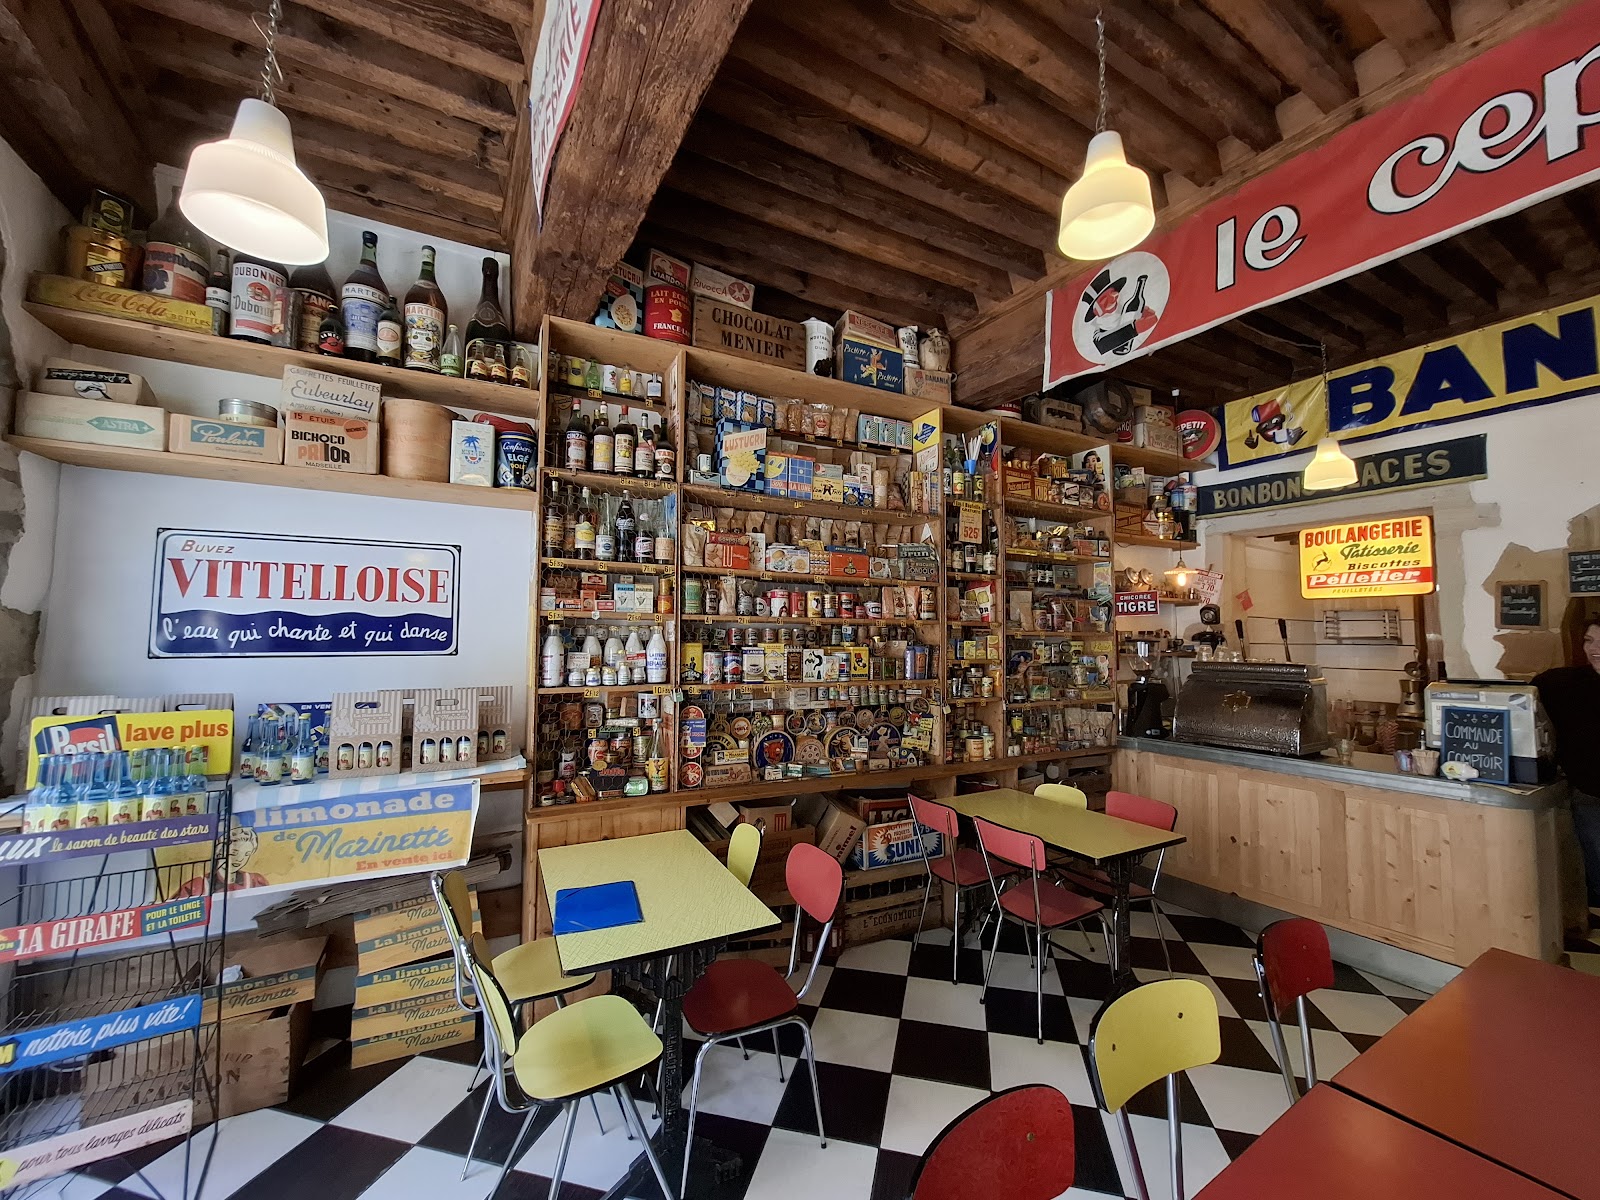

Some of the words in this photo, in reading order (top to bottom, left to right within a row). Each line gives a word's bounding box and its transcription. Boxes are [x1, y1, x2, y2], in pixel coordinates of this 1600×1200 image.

[1215, 204, 1308, 292] le
[73, 284, 168, 318] Coca-Cola
[712, 307, 793, 342] CHOCOLAT
[721, 330, 785, 360] MENIER
[102, 420, 140, 432] ASTRA
[1181, 420, 1207, 431] PETIT
[291, 430, 345, 445] BICHOCO
[724, 433, 765, 452] LUSTUCRU
[1213, 475, 1316, 510] BONBON
[963, 526, 980, 540] 525
[1304, 519, 1423, 548] BOULANGERIE
[1340, 541, 1421, 560] Patisserie
[1347, 559, 1421, 571] Biscottes
[166, 557, 450, 604] VITTELLOISE
[1116, 600, 1157, 613] TIGRE
[162, 616, 219, 642] l'eau
[227, 622, 263, 649] qui
[267, 617, 333, 642] chante
[338, 620, 358, 641] et
[364, 623, 394, 648] qui
[399, 621, 449, 643] danse
[51, 722, 118, 754] Persil
[125, 723, 175, 743] lave
[180, 719, 229, 742] plus
[1445, 721, 1504, 745] COMMANDE
[1463, 741, 1480, 750] AU
[253, 790, 455, 828] limonade
[0, 836, 53, 860] UX
[50, 837, 63, 853] le
[66, 833, 103, 851] savon
[103, 833, 119, 847] de
[120, 827, 159, 845] beauté
[160, 824, 179, 839] des
[179, 822, 210, 837] stars
[272, 830, 298, 843] de
[295, 825, 454, 865] Marinette
[886, 838, 925, 861] SUNI
[355, 860, 382, 872] En
[381, 854, 431, 869] vente
[431, 850, 454, 863] ici
[15, 926, 45, 957] LA
[50, 909, 136, 950] GIRAFE
[145, 906, 167, 921] POUR
[169, 905, 178, 916] LE
[179, 899, 202, 914] LINGE
[146, 923, 157, 932] ET
[157, 919, 168, 930] LA
[168, 910, 202, 926] TOILETTE
[374, 937, 393, 950] La
[373, 973, 392, 984] La
[368, 1005, 387, 1016] La
[22, 1022, 94, 1057] nettoie
[91, 1014, 141, 1049] plus
[142, 998, 194, 1030] vite!
[405, 1029, 463, 1049] Marinette
[16, 1152, 52, 1177] pour
[55, 1143, 83, 1161] tous
[84, 1126, 136, 1152] lavages
[137, 1111, 186, 1137] délicats
